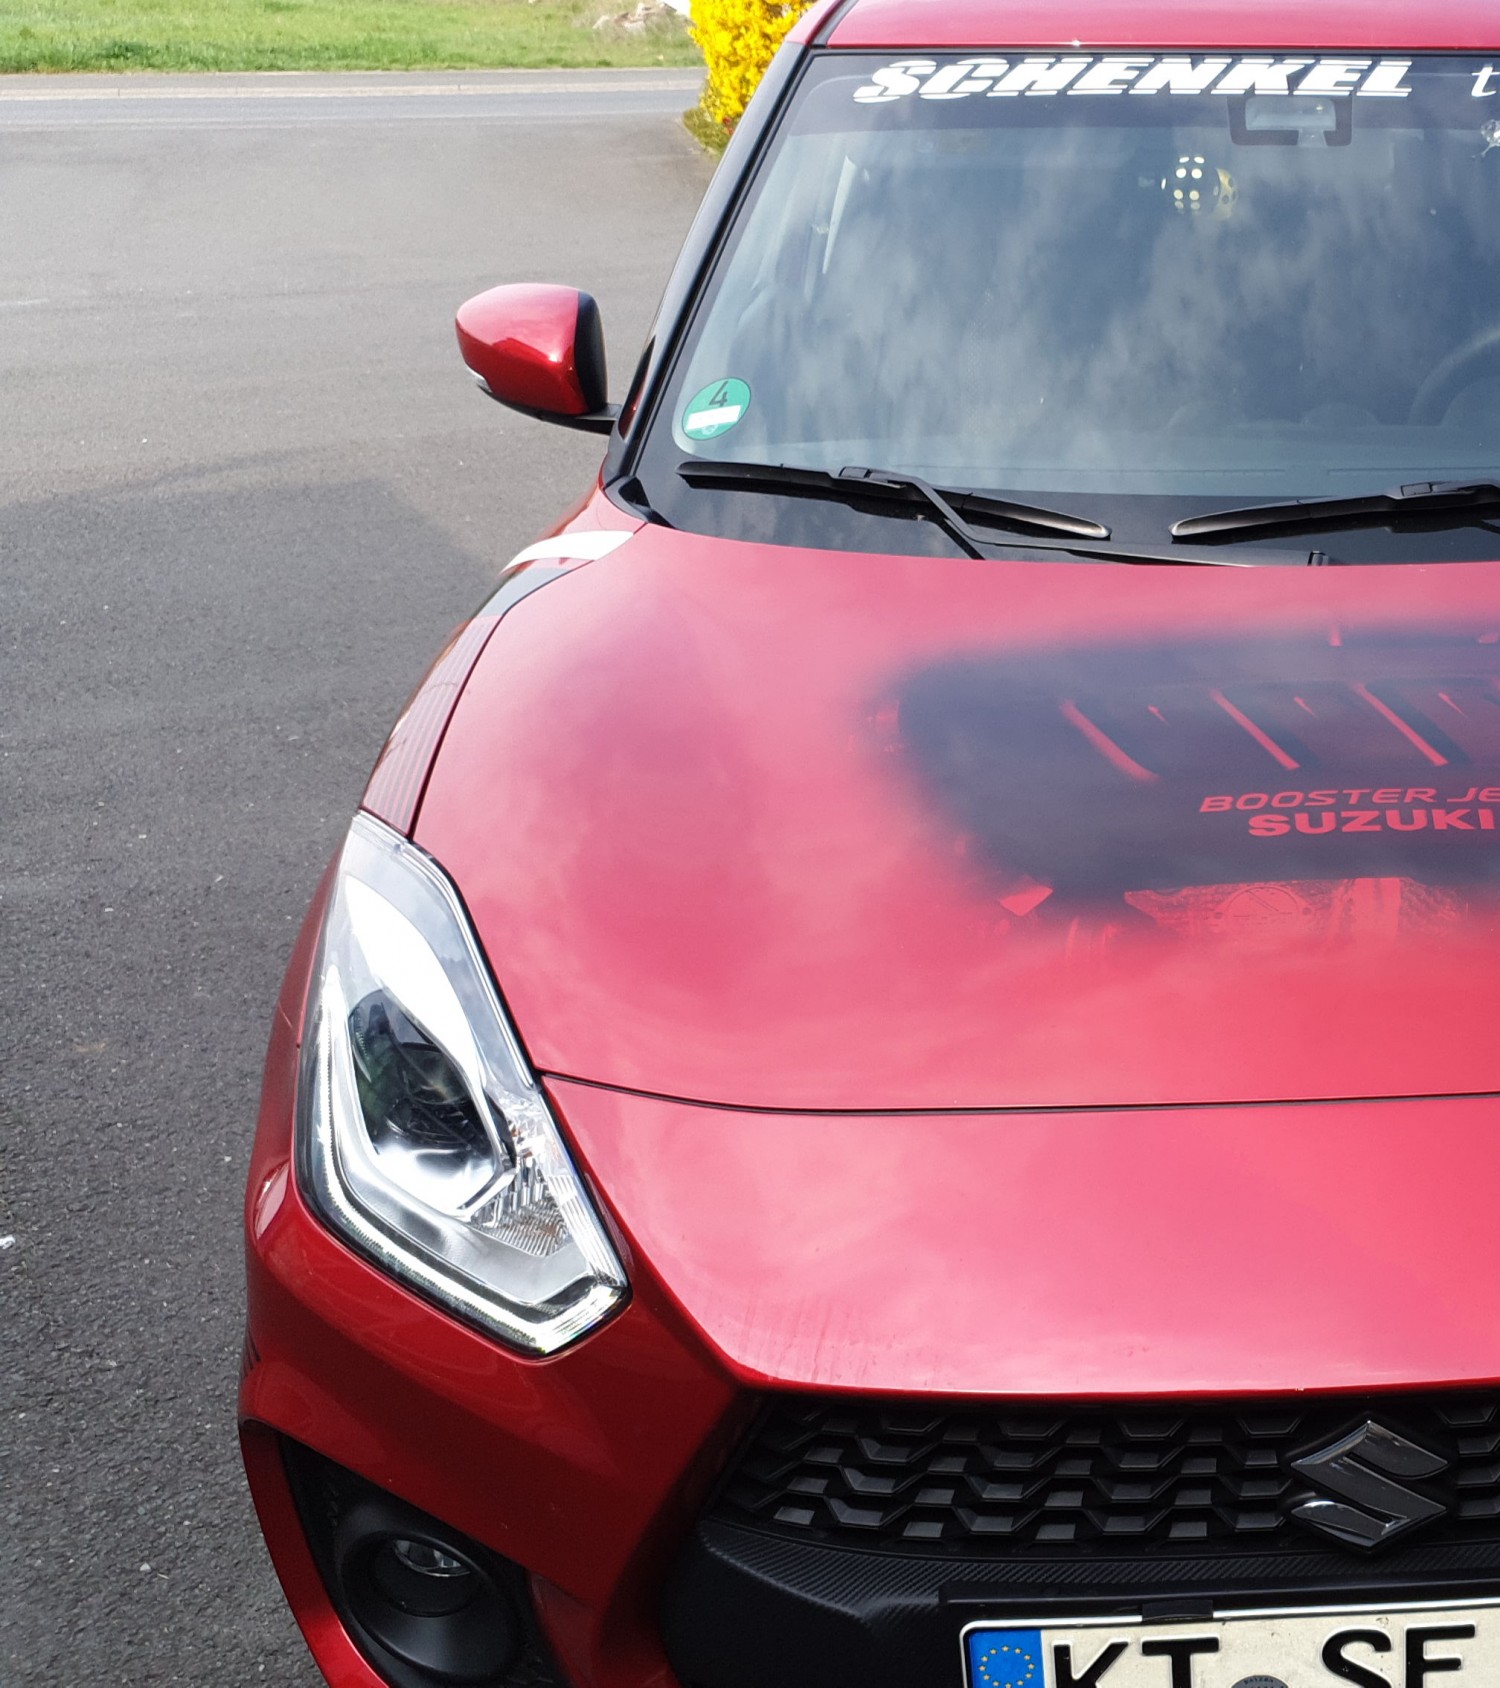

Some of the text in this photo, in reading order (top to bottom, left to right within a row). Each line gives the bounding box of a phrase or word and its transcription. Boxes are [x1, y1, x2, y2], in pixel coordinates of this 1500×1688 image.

[853, 57, 1411, 104] SCHENKEL
[708, 380, 729, 407] 4
[1200, 788, 1437, 813] BOOSTER
[1248, 808, 1495, 837] SUZUKI
